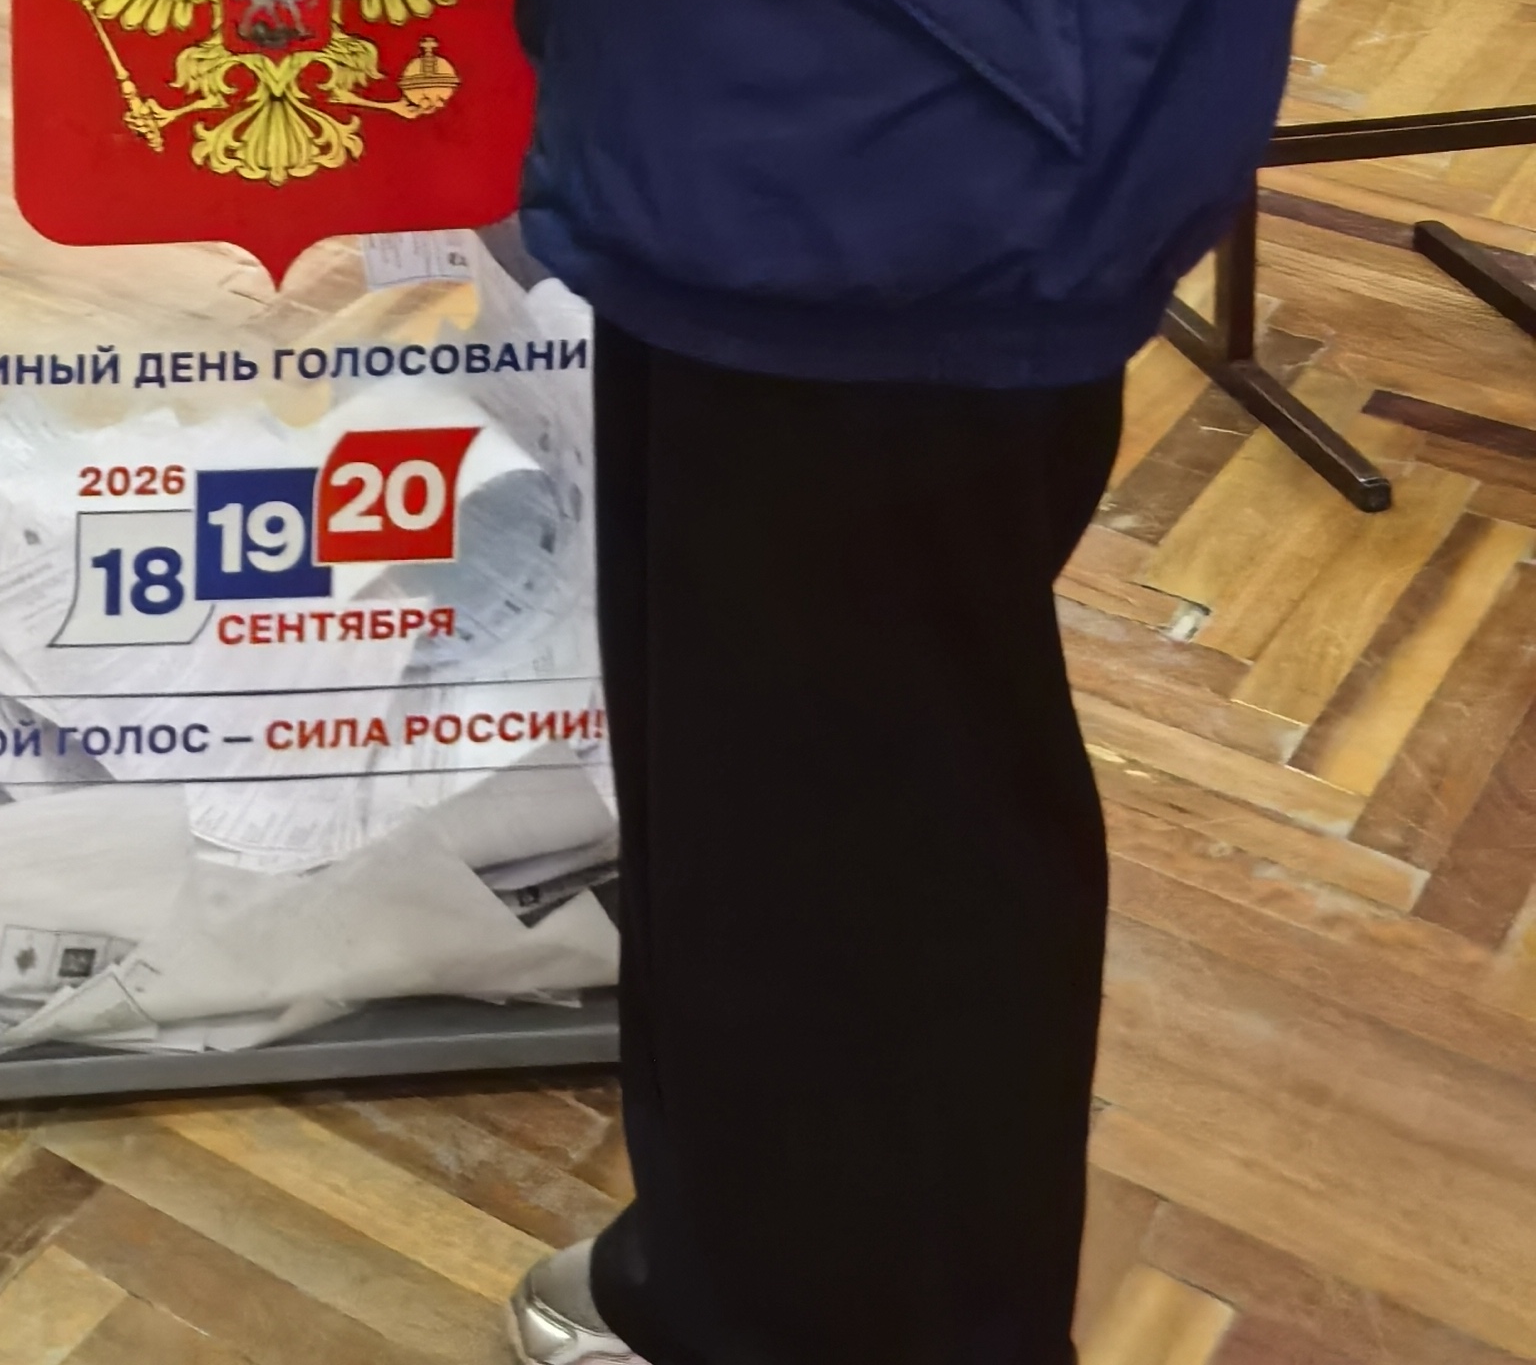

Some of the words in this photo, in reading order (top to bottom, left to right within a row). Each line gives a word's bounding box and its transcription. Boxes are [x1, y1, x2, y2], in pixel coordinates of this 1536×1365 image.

[135, 349, 259, 388] ДЕНЬ
[273, 339, 589, 380] ГОЛОСОВАНИ
[78, 465, 186, 498] 2026
[328, 459, 447, 533] 20
[207, 501, 306, 575] 19
[91, 546, 184, 616] 18
[217, 607, 456, 647] СЕНТЯБРЯ
[57, 723, 210, 756] ГОЛОС
[265, 716, 389, 753] СИЛА
[405, 709, 606, 746] РОССИИ!
